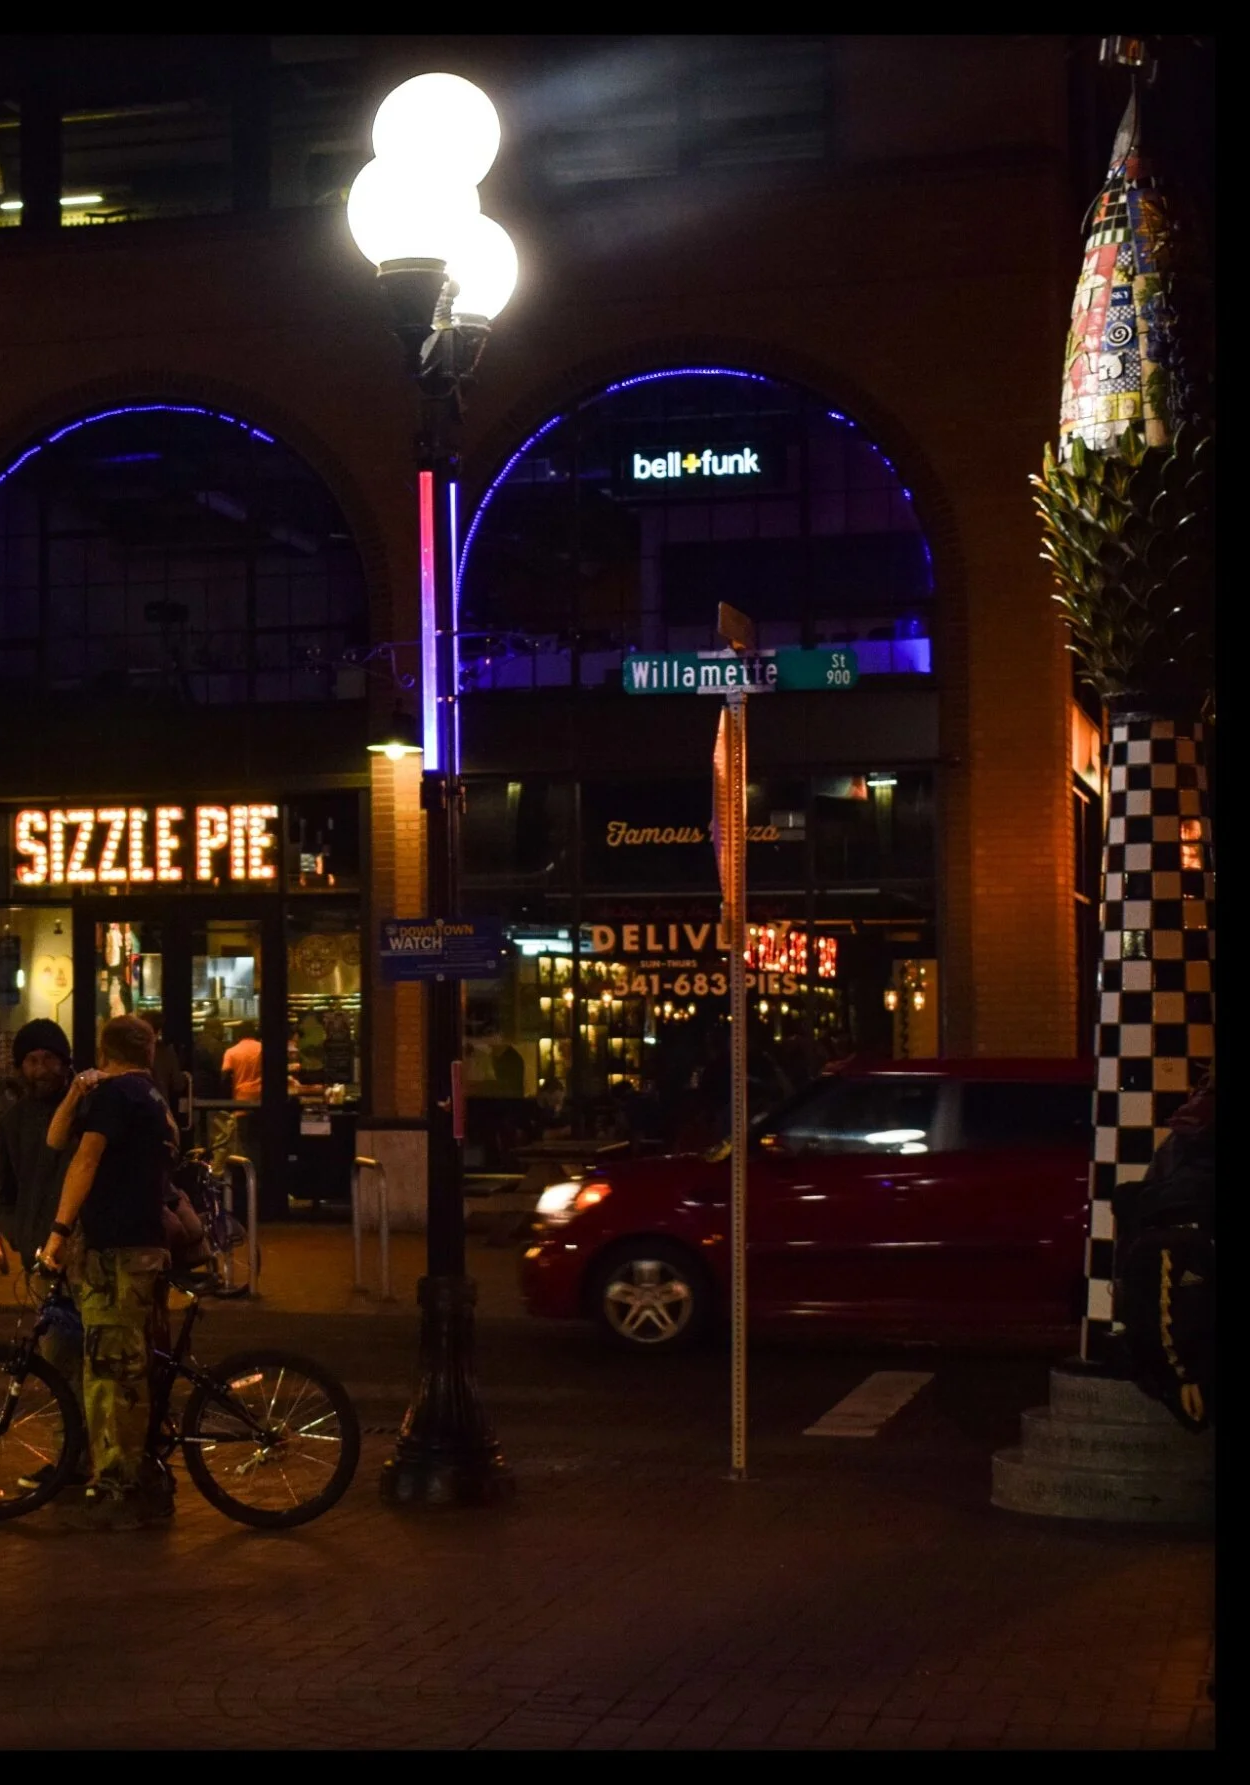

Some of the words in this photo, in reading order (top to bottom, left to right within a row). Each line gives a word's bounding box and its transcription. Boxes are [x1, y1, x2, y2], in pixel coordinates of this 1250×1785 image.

[633, 448, 761, 479] bell+funk
[831, 653, 846, 668] St
[631, 660, 778, 689] Willamette
[826, 669, 851, 685] 900
[14, 805, 185, 886] SIZZLE
[194, 803, 280, 882] PIE
[606, 820, 705, 847] Famous
[389, 936, 443, 951] WATCH
[399, 924, 475, 937] DOWNTOWN
[613, 972, 799, 998] 541-683PIES
